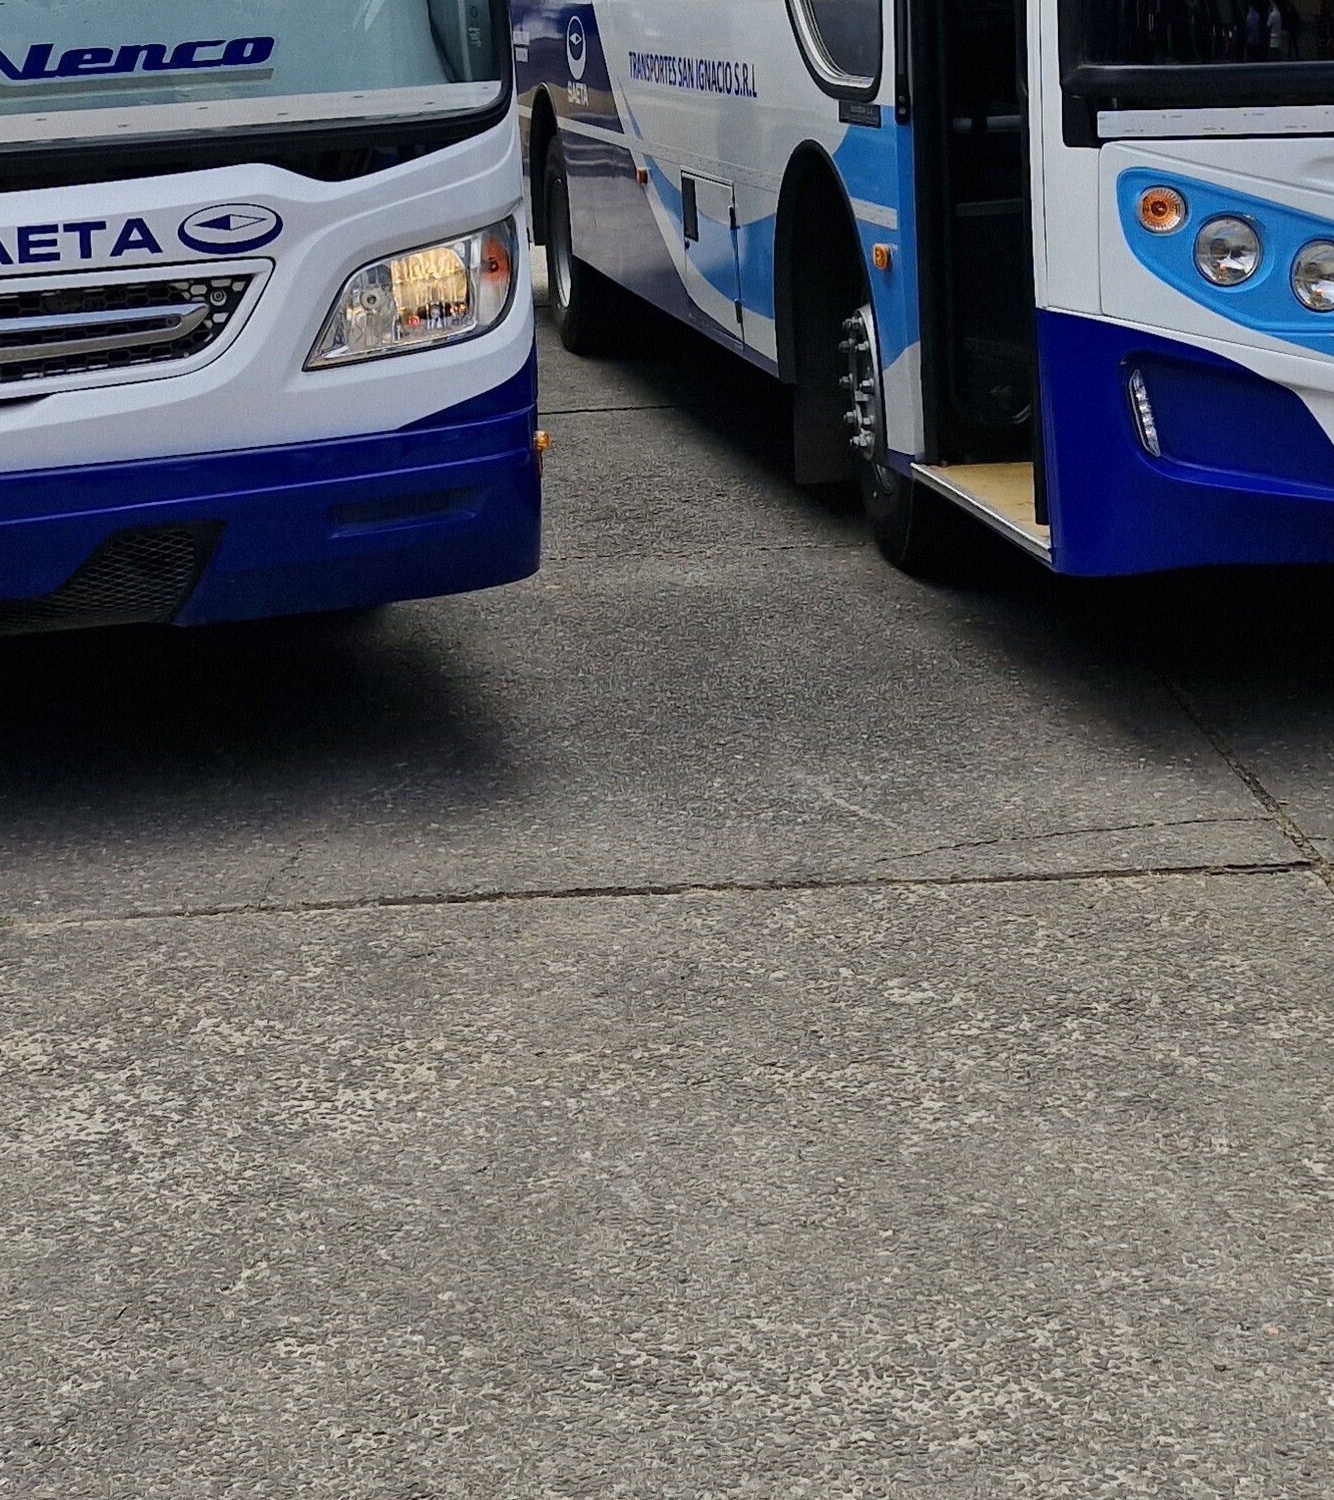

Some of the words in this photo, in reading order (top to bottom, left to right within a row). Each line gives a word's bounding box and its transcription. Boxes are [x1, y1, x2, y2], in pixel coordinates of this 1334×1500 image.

[628, 51, 676, 86] TRANSPORTES
[677, 57, 694, 89] SAN
[695, 58, 732, 95] IGNACIO
